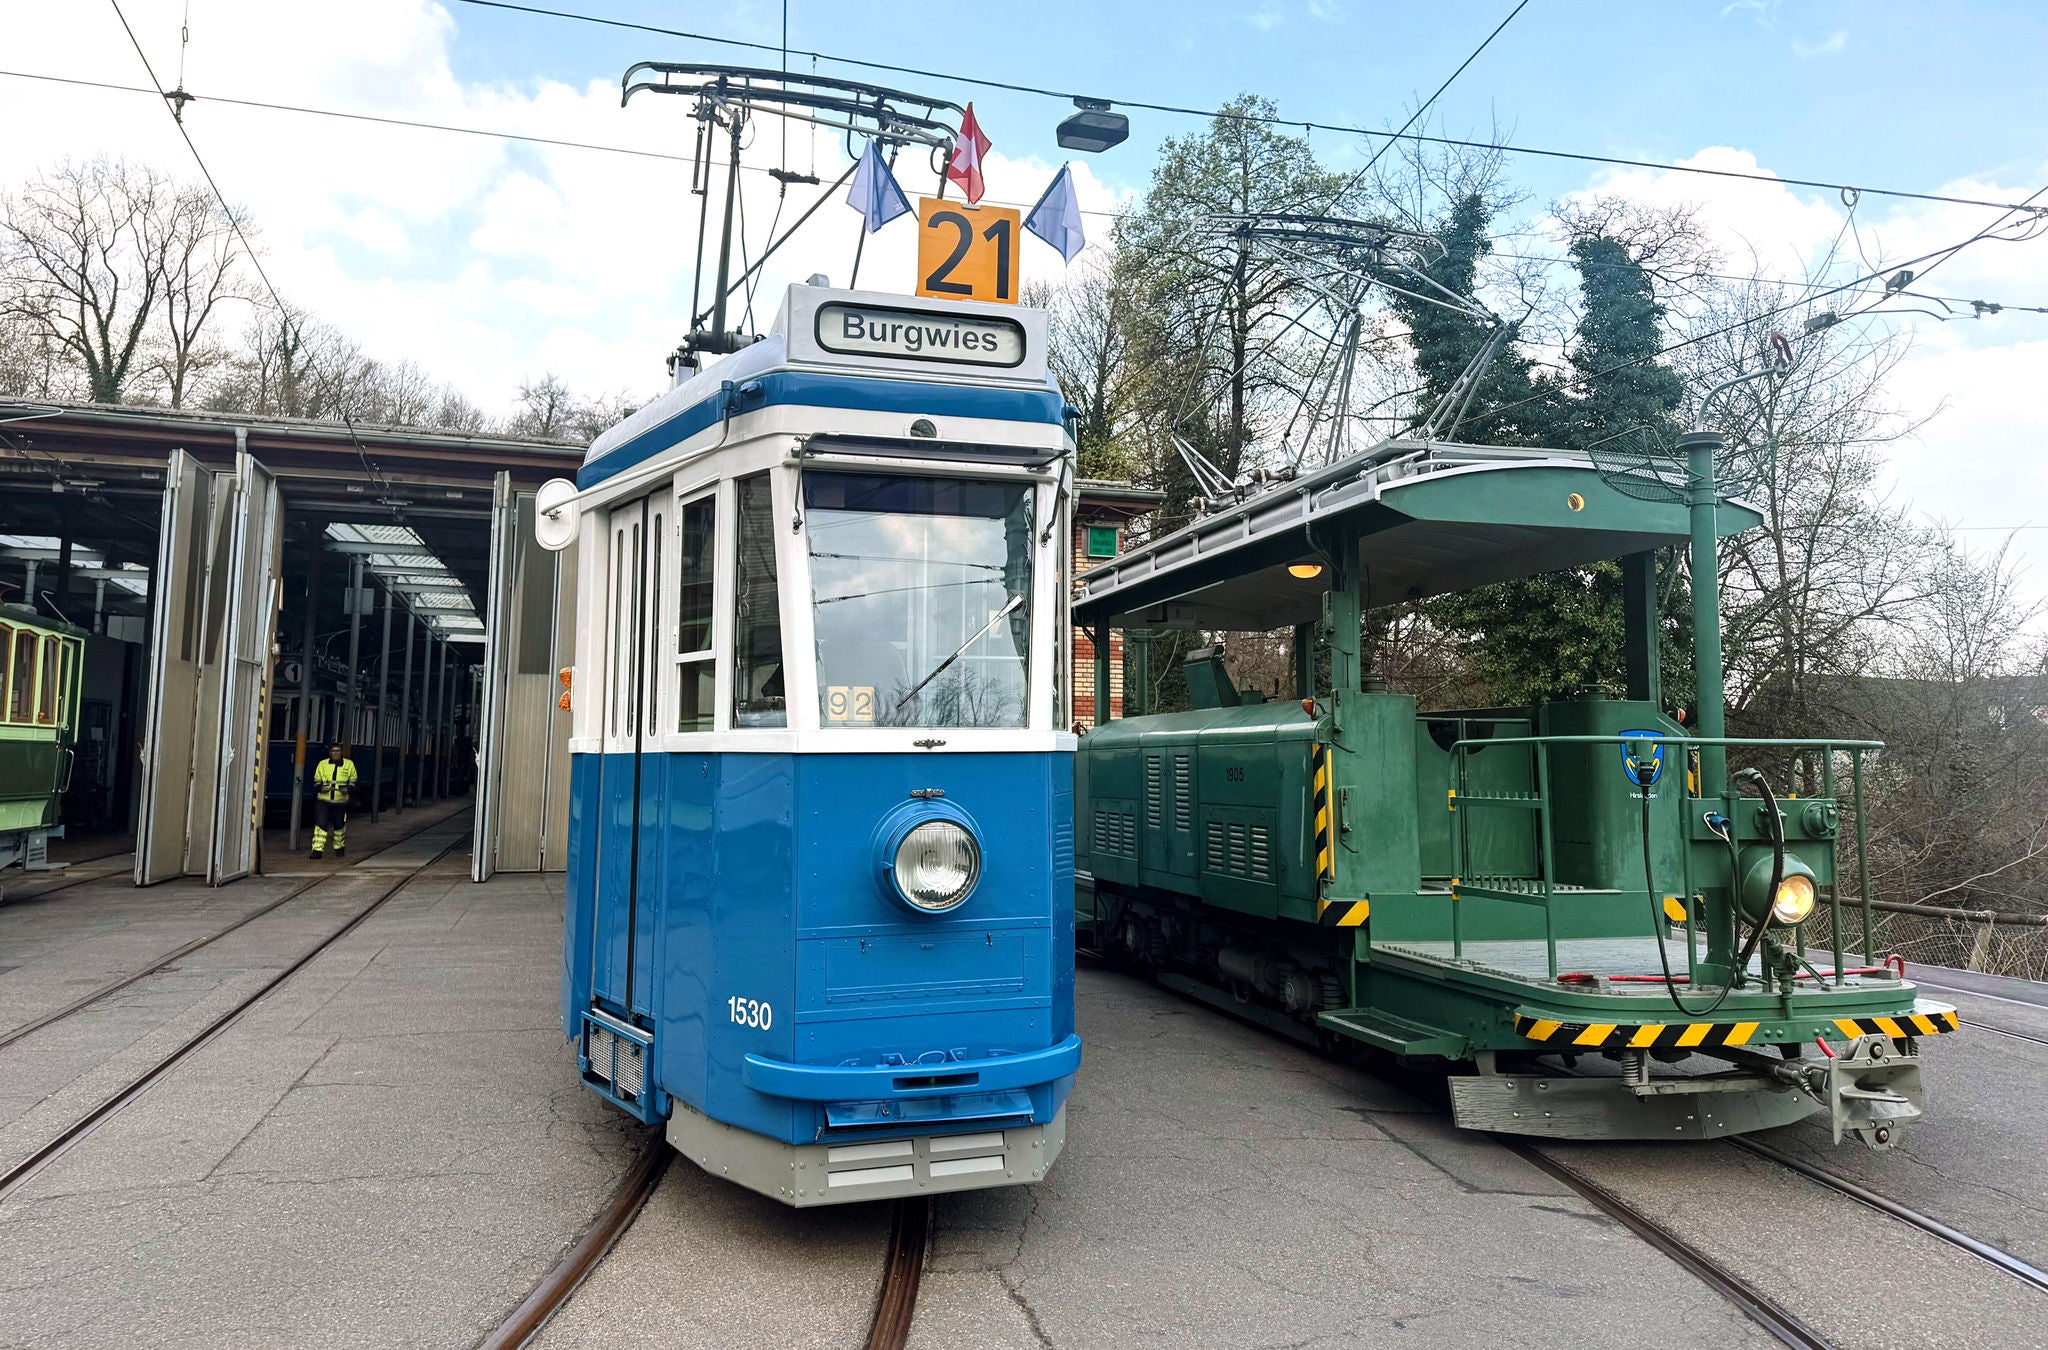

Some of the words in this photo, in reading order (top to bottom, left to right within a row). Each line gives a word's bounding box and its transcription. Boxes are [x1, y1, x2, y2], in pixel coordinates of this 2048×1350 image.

[926, 211, 1010, 299] 21
[842, 312, 998, 352] Burgwies
[291, 664, 299, 681] 1
[829, 691, 872, 716] 92
[1226, 767, 1245, 782] 1905
[727, 995, 772, 1031] 1530
